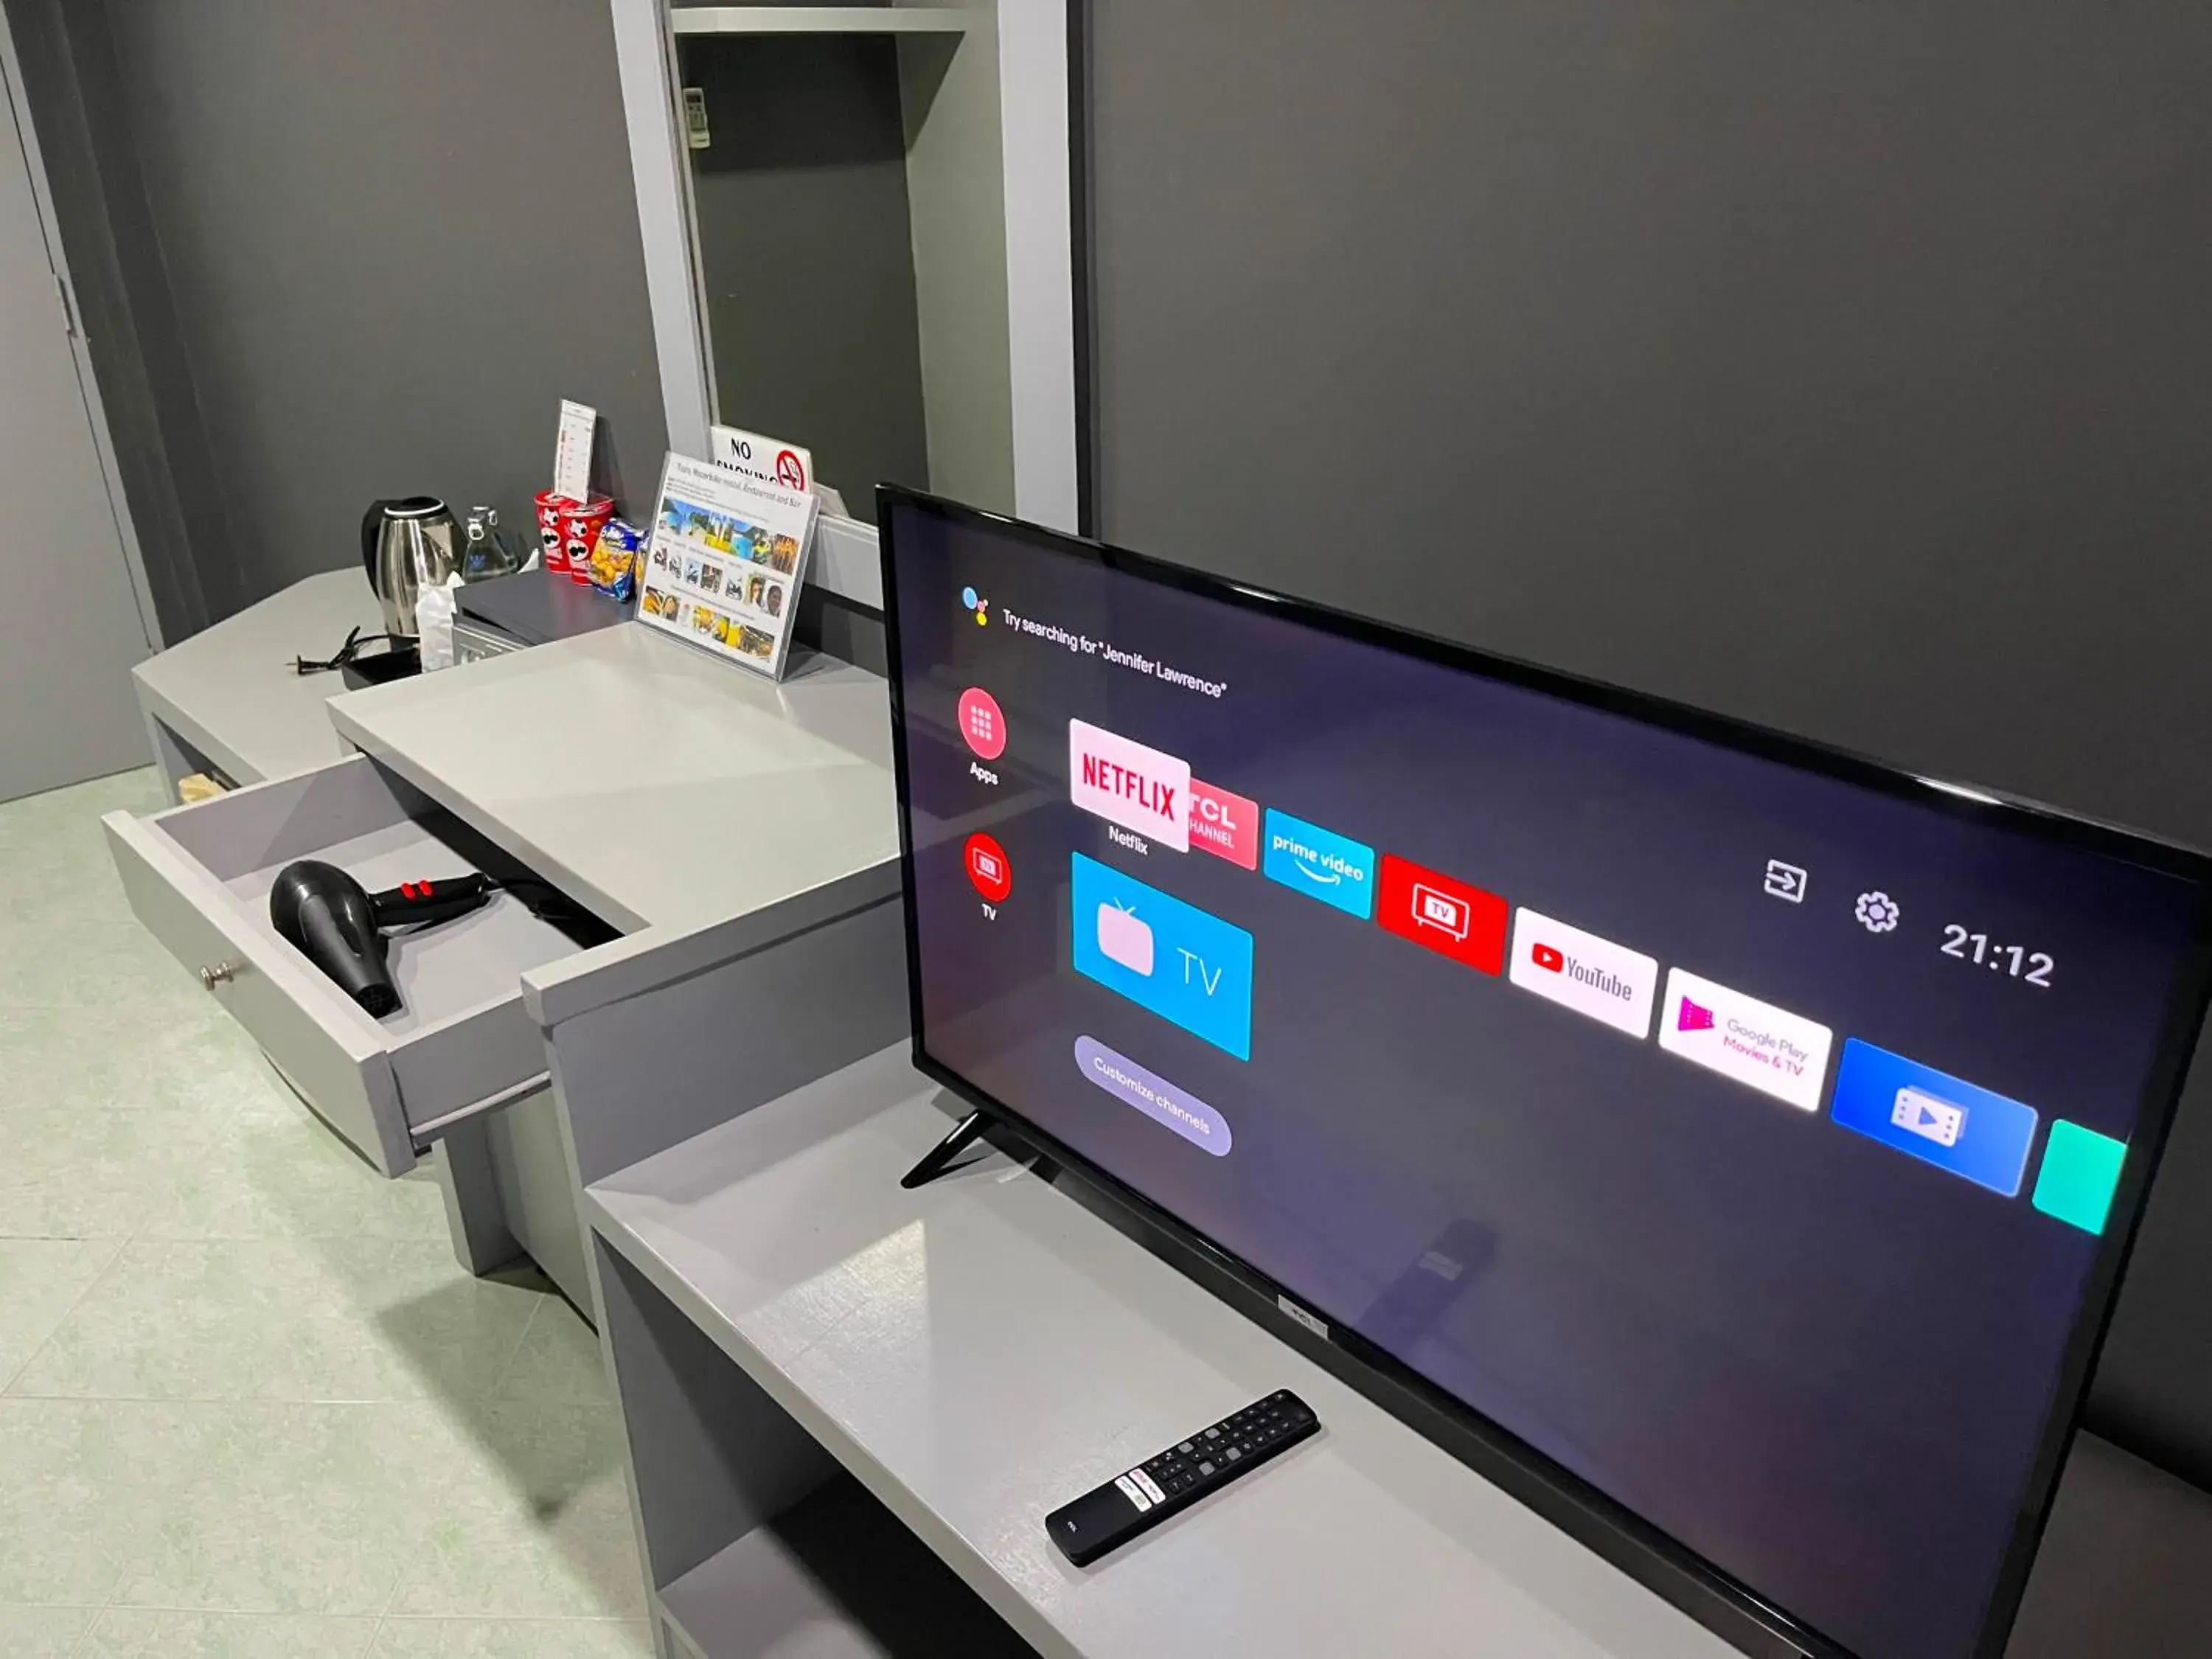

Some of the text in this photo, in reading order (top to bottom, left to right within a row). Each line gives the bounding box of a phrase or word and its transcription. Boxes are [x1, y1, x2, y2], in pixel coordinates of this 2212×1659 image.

[731, 438, 751, 460] NO
[1003, 608, 1021, 631] Try
[1022, 619, 1079, 652] searching
[1079, 635, 1097, 654] for
[970, 762, 998, 785] Apps
[1083, 753, 1175, 821] NETFLIX
[1108, 825, 1149, 855] Netflix
[1189, 818, 1235, 849] HANNEL
[1273, 835, 1363, 881] prime video
[981, 902, 996, 921] TV
[1431, 902, 1450, 919] TV
[1177, 947, 1222, 997] TV
[1940, 924, 2055, 988] 21:12
[1567, 956, 1632, 1001] YouTube
[1723, 1034, 1770, 1064] Movies
[1785, 1060, 1804, 1077] TV
[1727, 1018, 1809, 1062] Google Play
[1093, 1057, 1211, 1135] Customize channels
